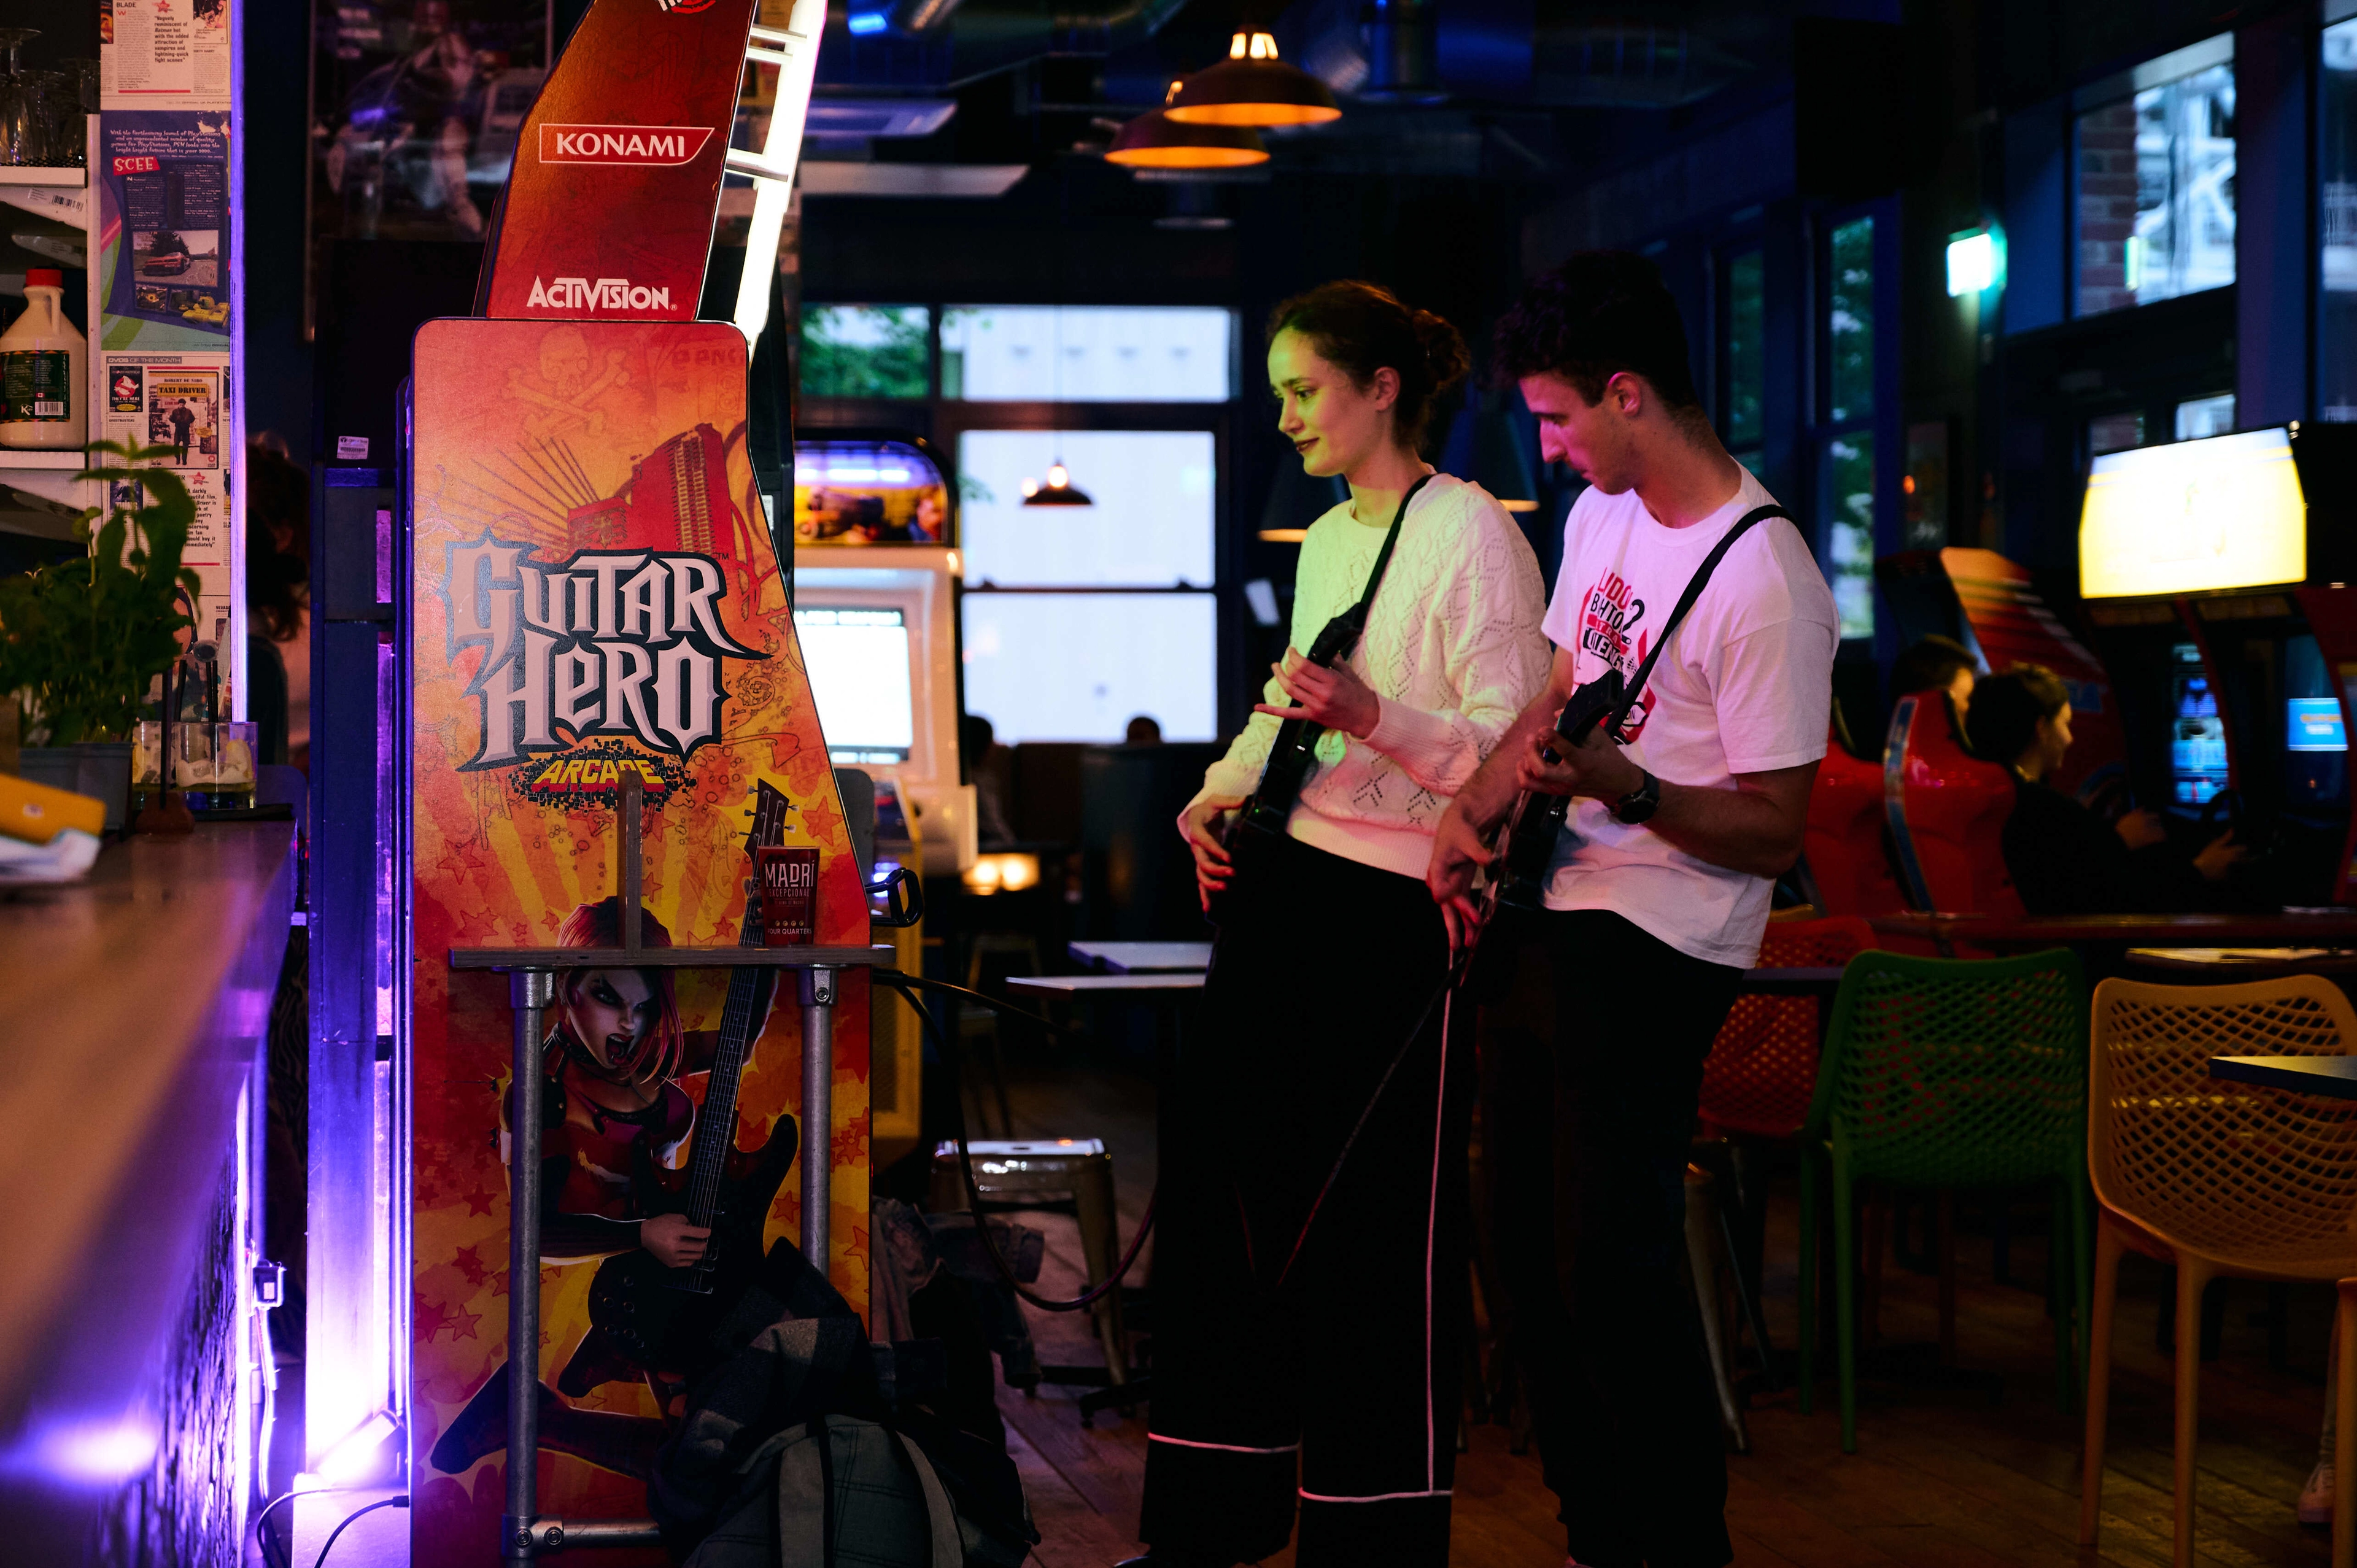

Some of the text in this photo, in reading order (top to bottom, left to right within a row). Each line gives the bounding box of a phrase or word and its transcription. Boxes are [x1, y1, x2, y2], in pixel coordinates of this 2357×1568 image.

[556, 133, 685, 157] KONAMI
[114, 157, 153, 171] SCEE
[527, 276, 669, 312] ACTIVISION
[447, 540, 753, 669] GUITAR
[479, 628, 721, 762] HERO
[764, 860, 815, 887] MADRÍ
[769, 889, 810, 897] EXCEPCIONAL
